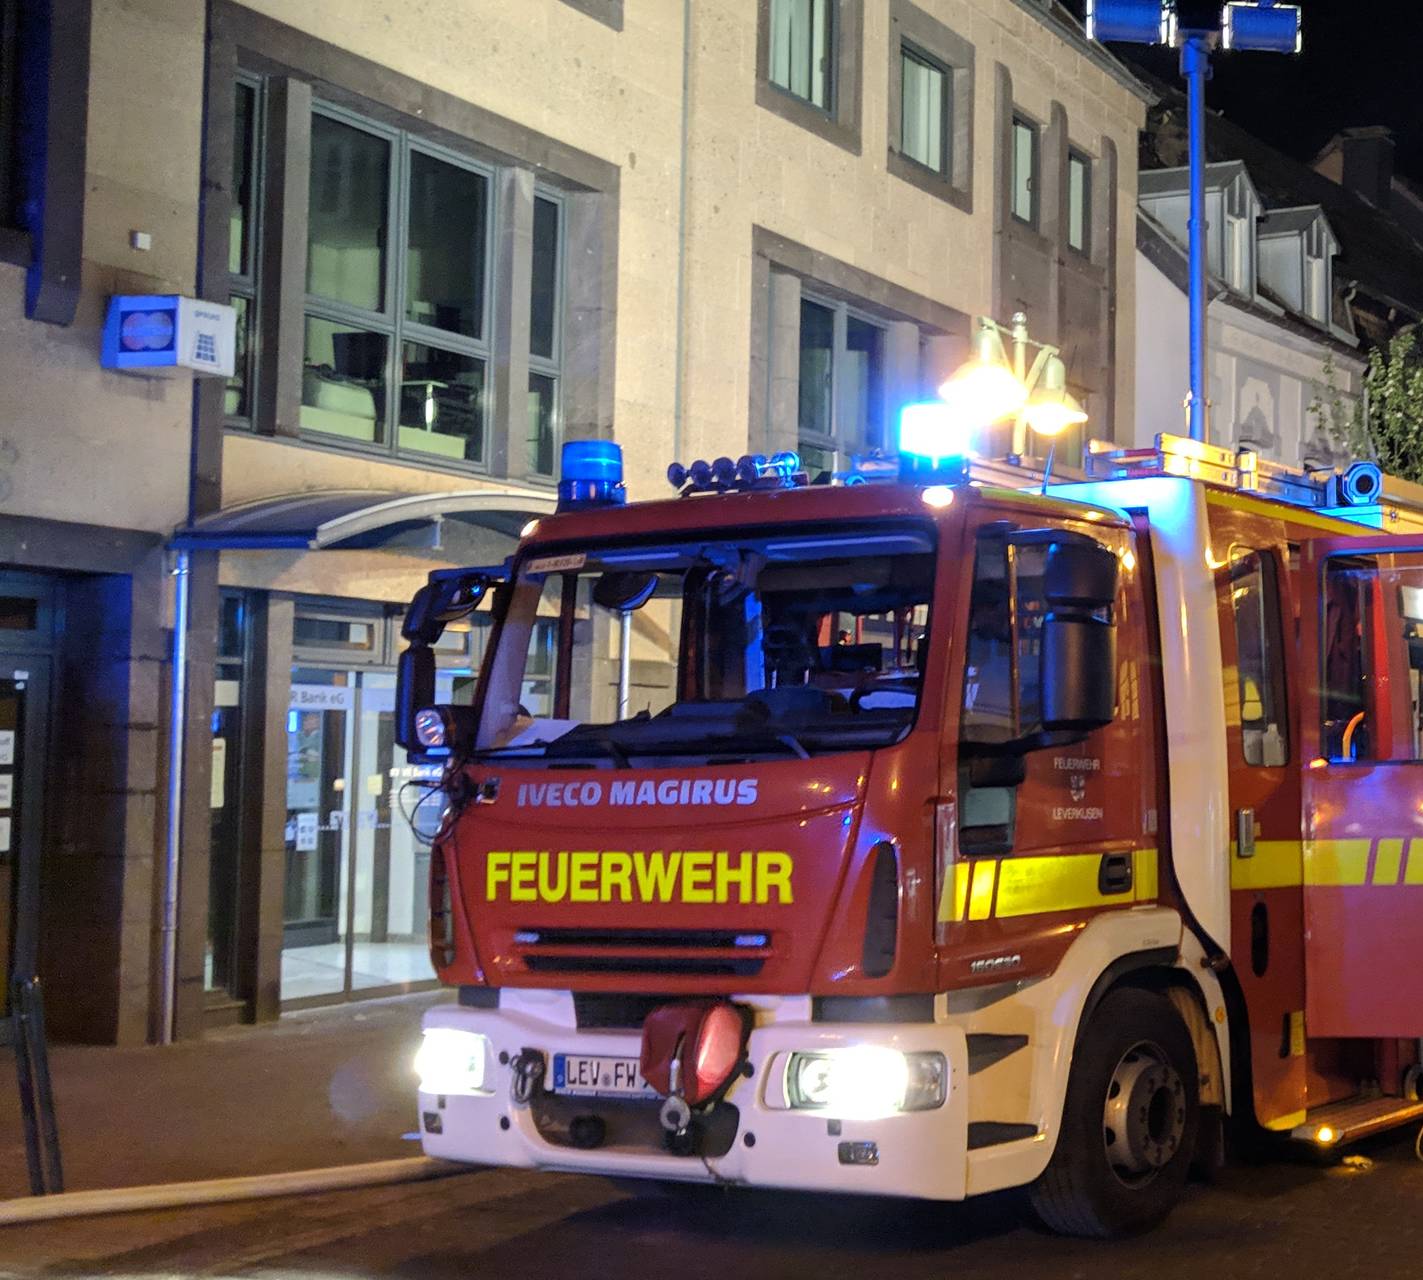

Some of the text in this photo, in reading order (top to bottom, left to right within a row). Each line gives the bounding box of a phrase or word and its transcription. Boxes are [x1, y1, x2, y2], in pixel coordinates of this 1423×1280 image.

[301, 690, 328, 704] Bank
[330, 692, 345, 705] eG
[517, 779, 759, 807] IVECO MAGIRUS
[486, 850, 795, 904] FEUERWEHR
[566, 1060, 637, 1087] LEV FW
